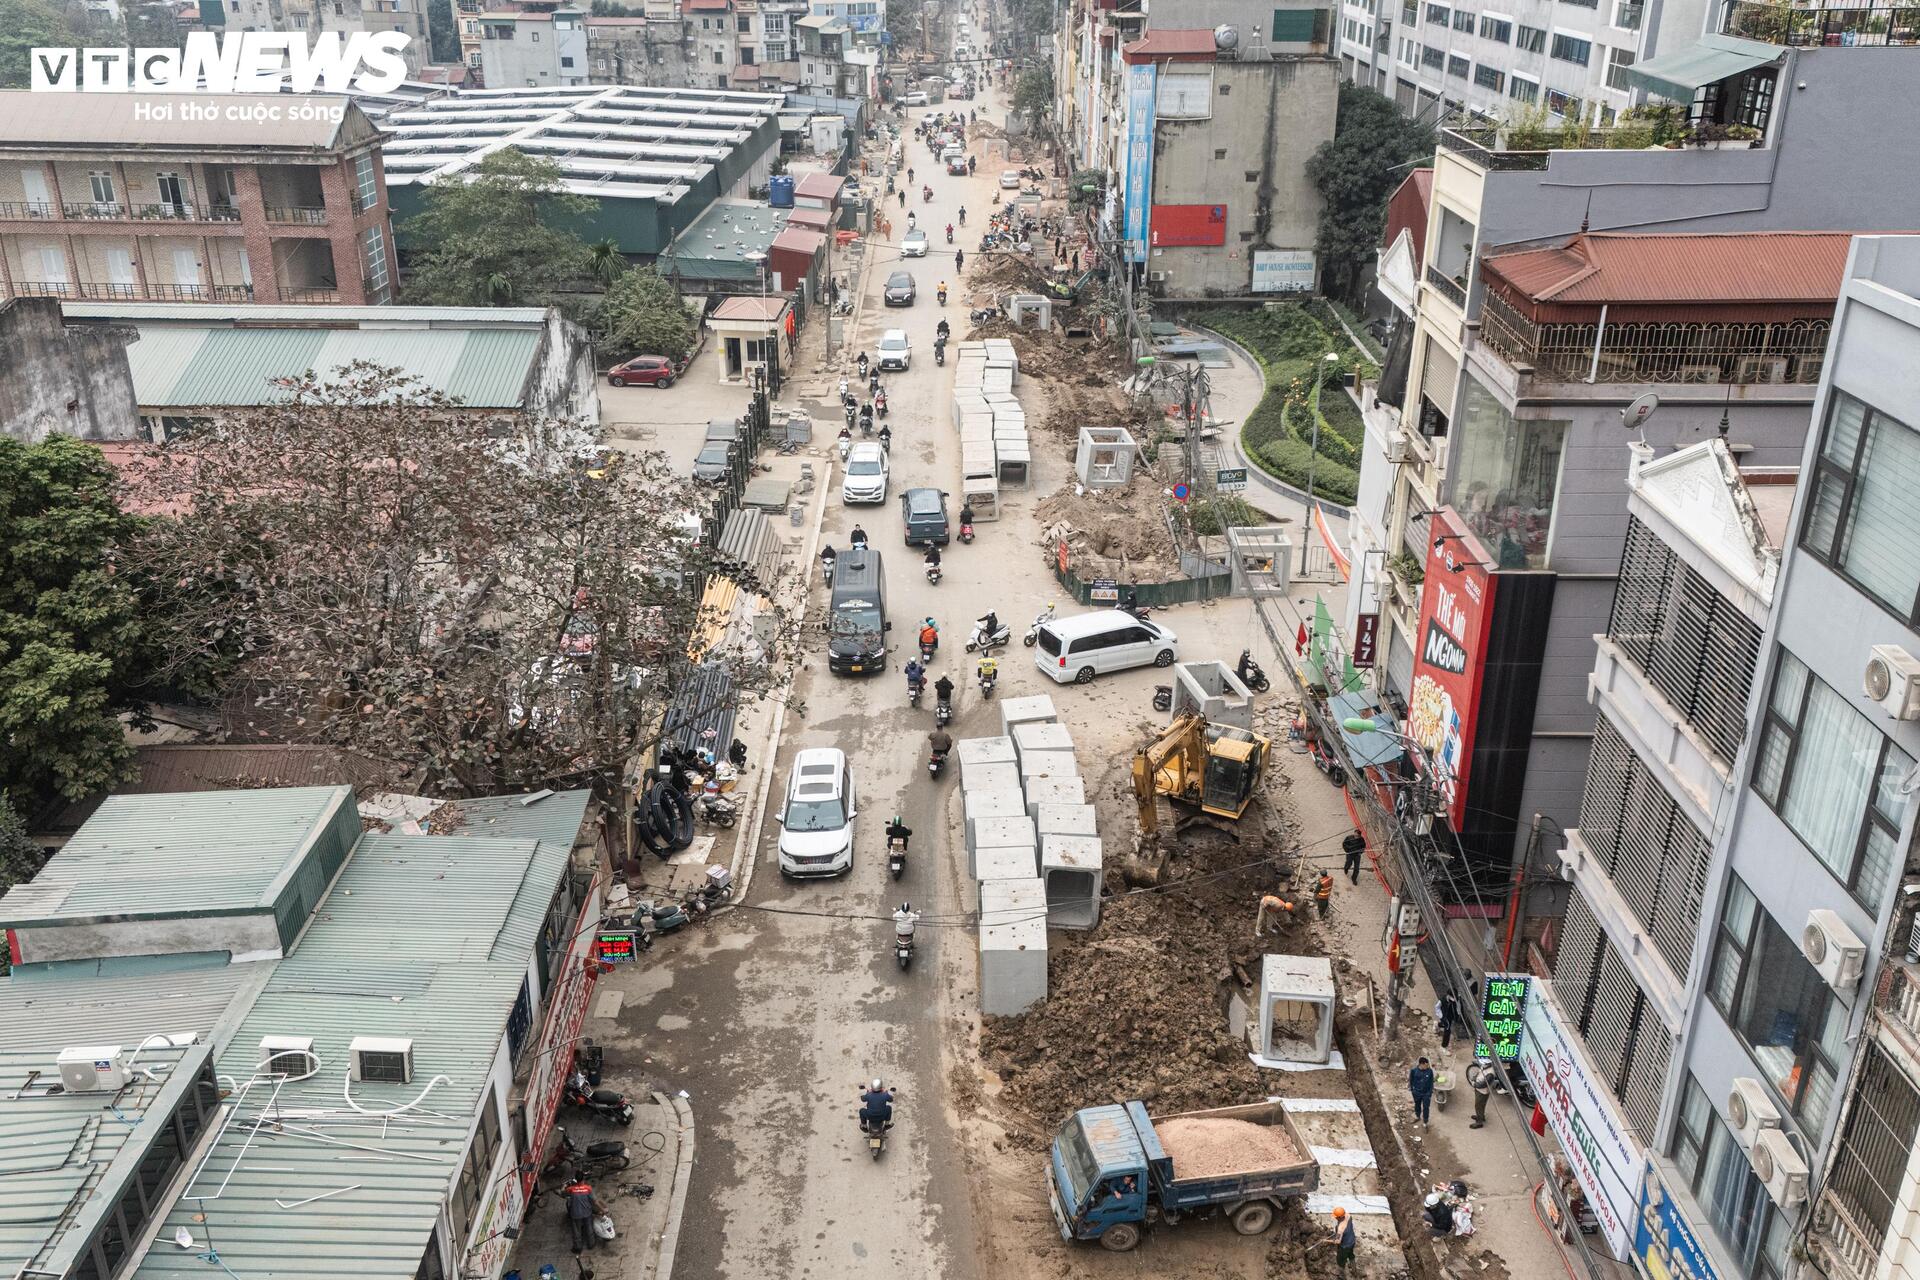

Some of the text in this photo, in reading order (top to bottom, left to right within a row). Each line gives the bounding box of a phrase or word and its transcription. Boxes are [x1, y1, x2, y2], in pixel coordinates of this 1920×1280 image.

[1361, 618, 1373, 660] 147
[1489, 998, 1517, 1015] CÂY
[1676, 1219, 1695, 1253] THỐNG
[1694, 1252, 1706, 1275] CỬA
